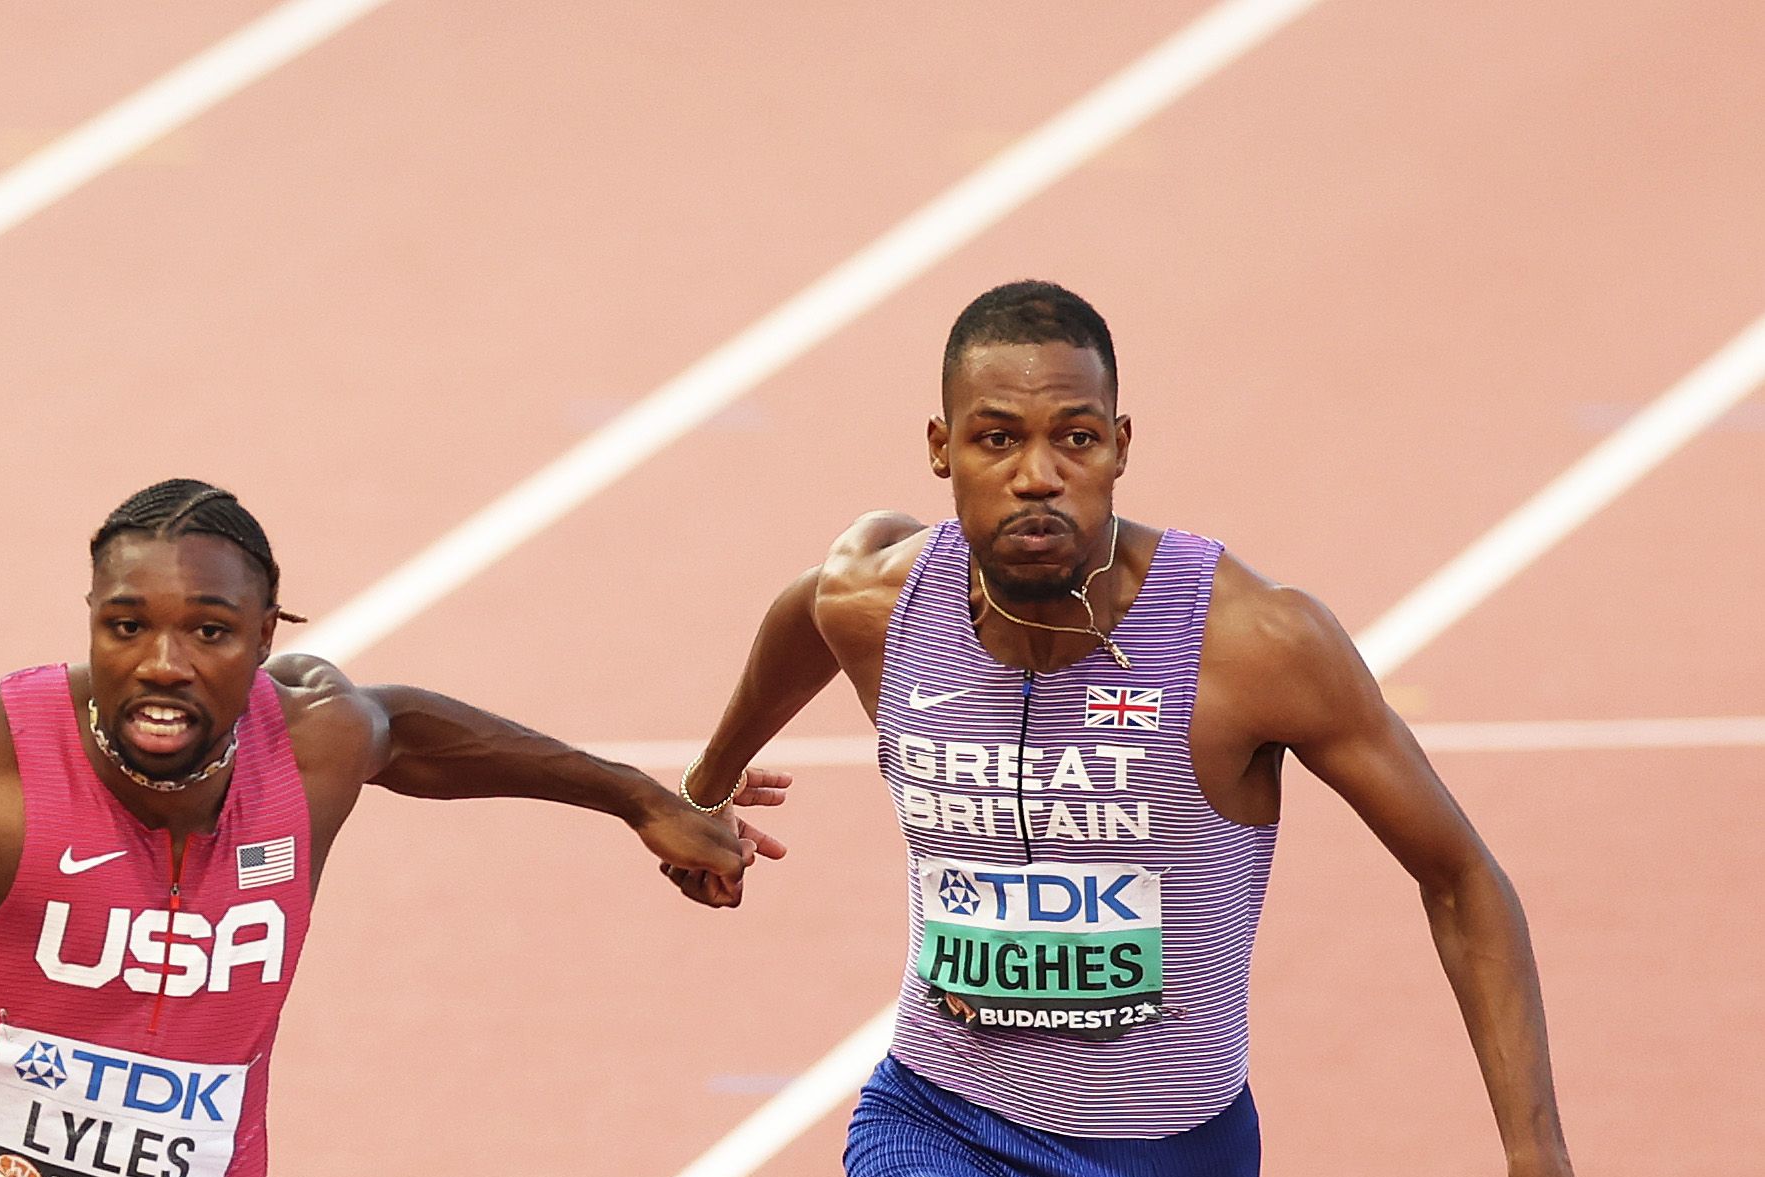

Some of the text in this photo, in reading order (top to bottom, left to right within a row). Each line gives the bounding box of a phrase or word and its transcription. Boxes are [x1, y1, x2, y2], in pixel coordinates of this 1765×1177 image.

[897, 733, 1146, 791] GREAT
[902, 785, 1151, 840] BRITAIN
[975, 873, 1141, 924] TDK
[35, 899, 286, 997] USA
[929, 935, 1144, 991] HUGHES
[71, 1049, 231, 1121] TDK
